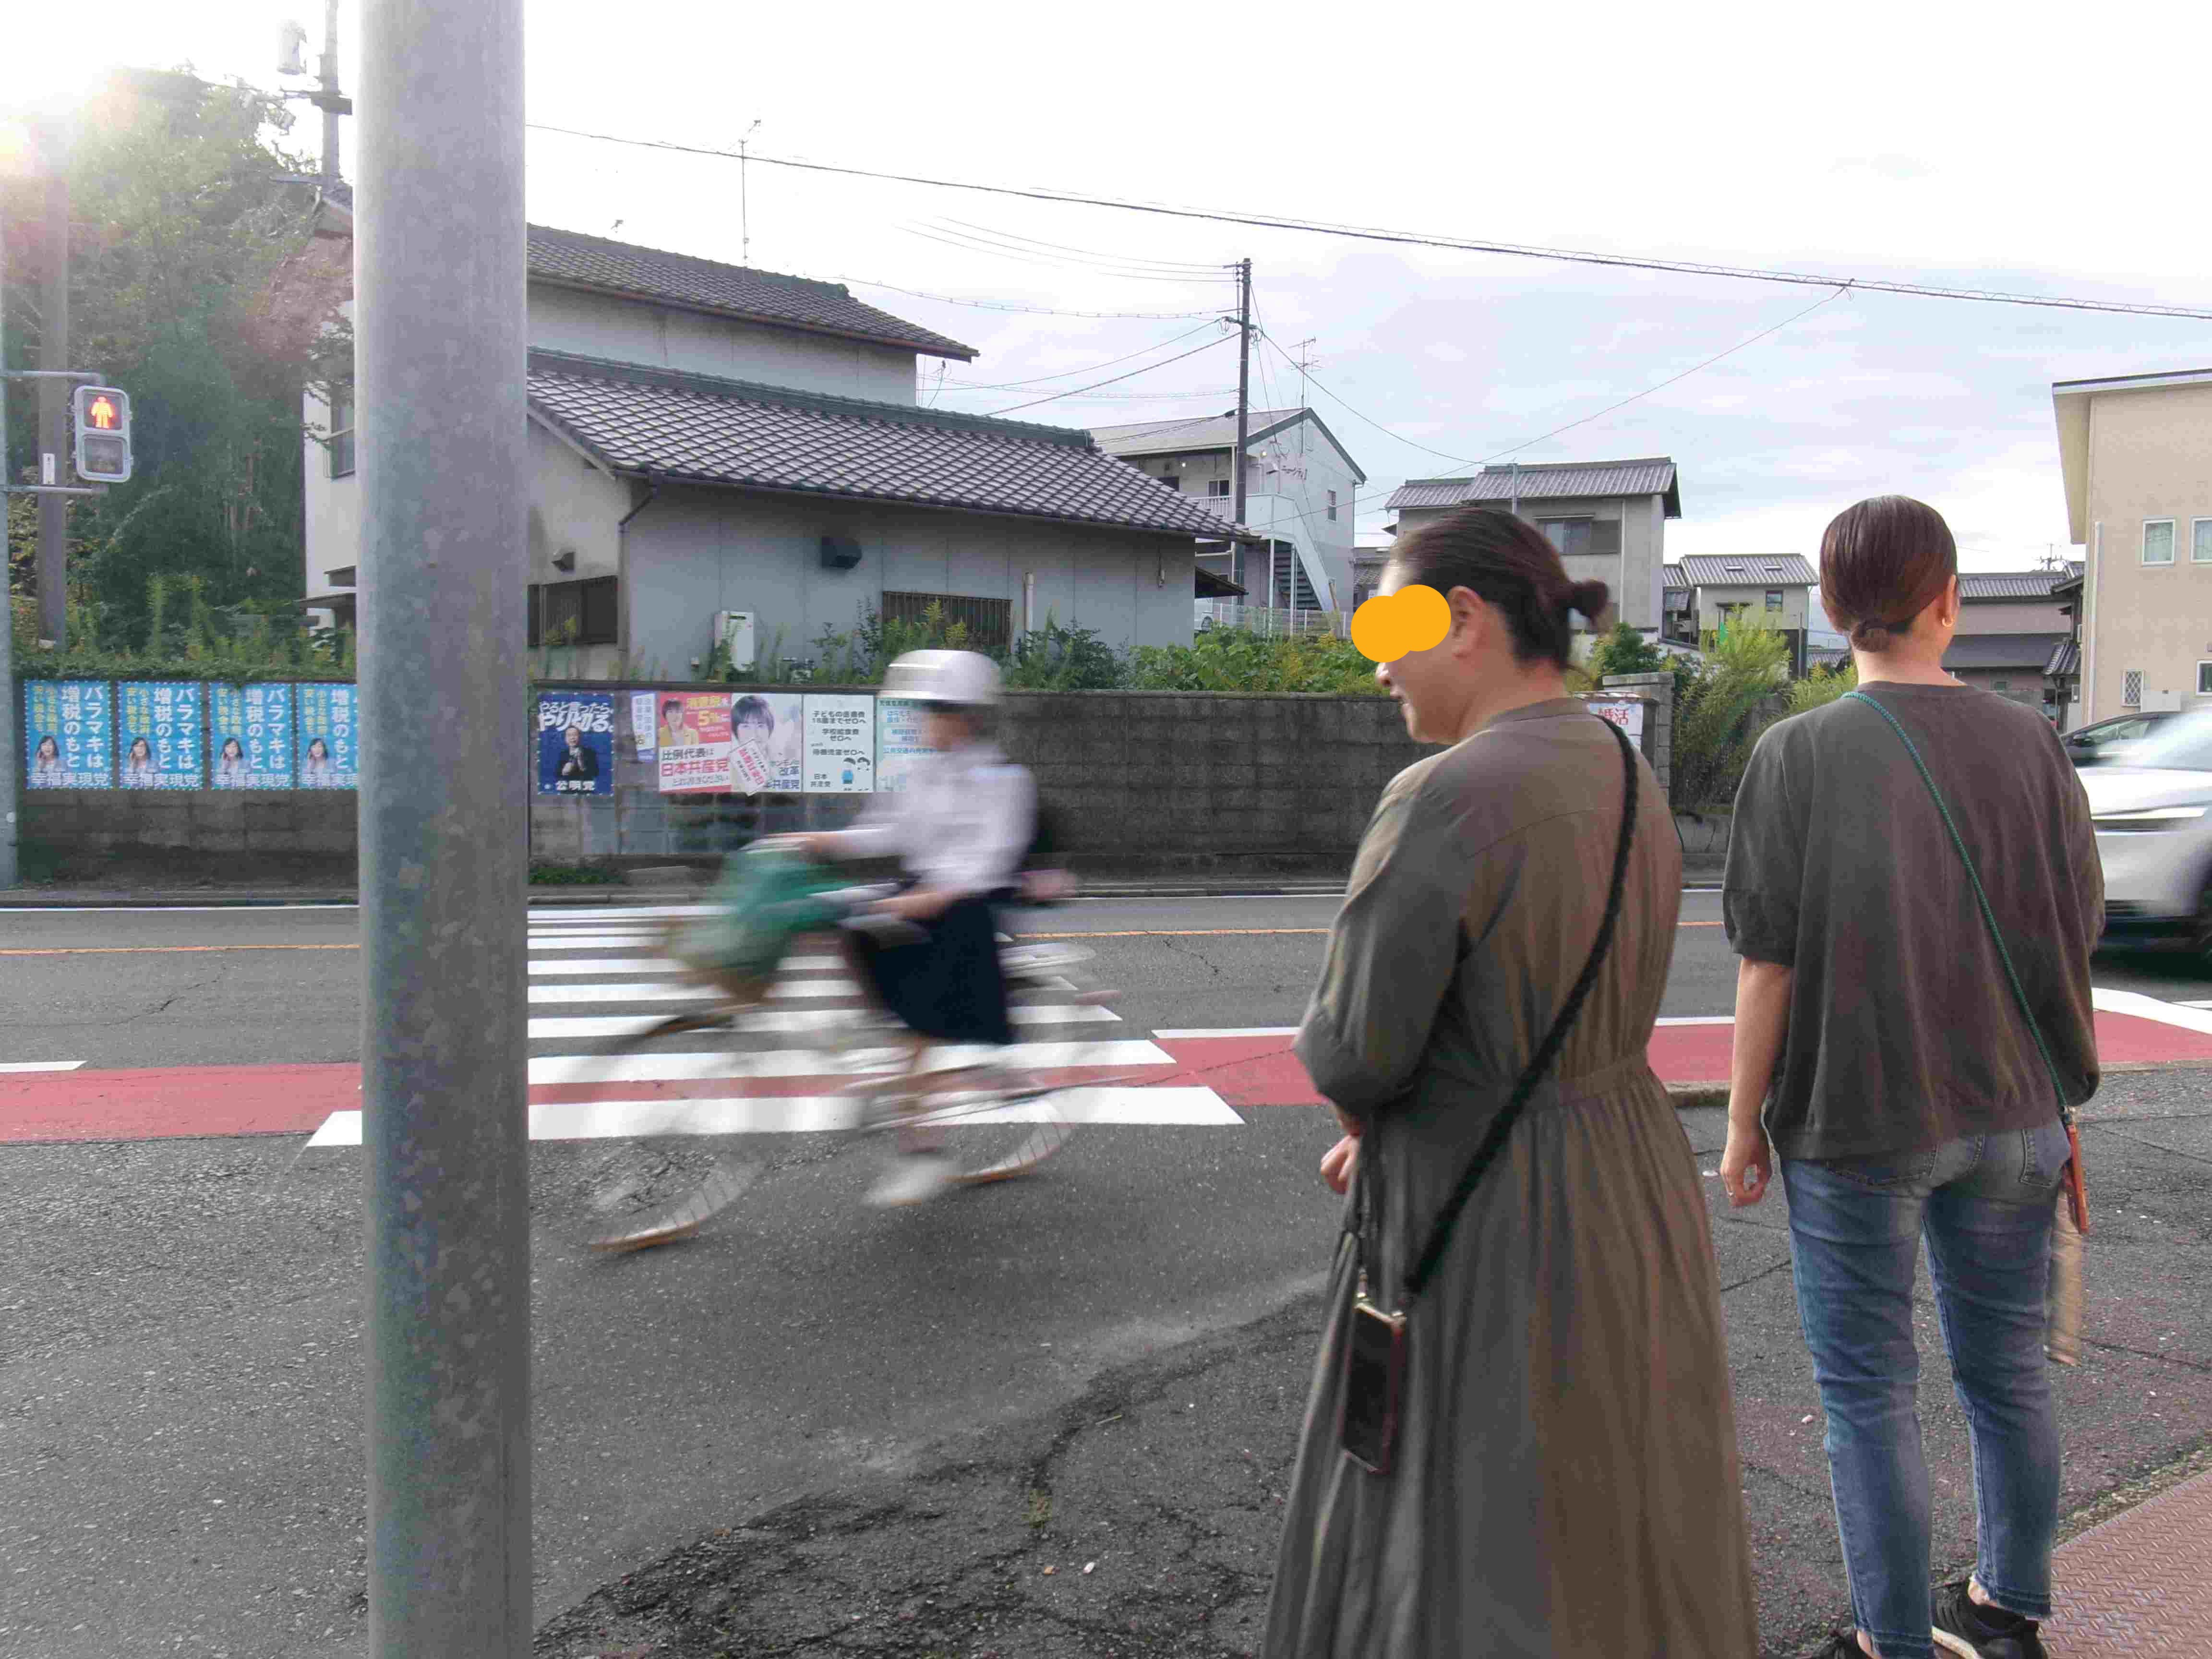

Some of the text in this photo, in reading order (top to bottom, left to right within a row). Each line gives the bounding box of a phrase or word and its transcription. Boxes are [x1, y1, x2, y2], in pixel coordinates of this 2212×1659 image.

[661, 757, 730, 777] 日本共産党
[555, 780, 596, 791] 公明党
